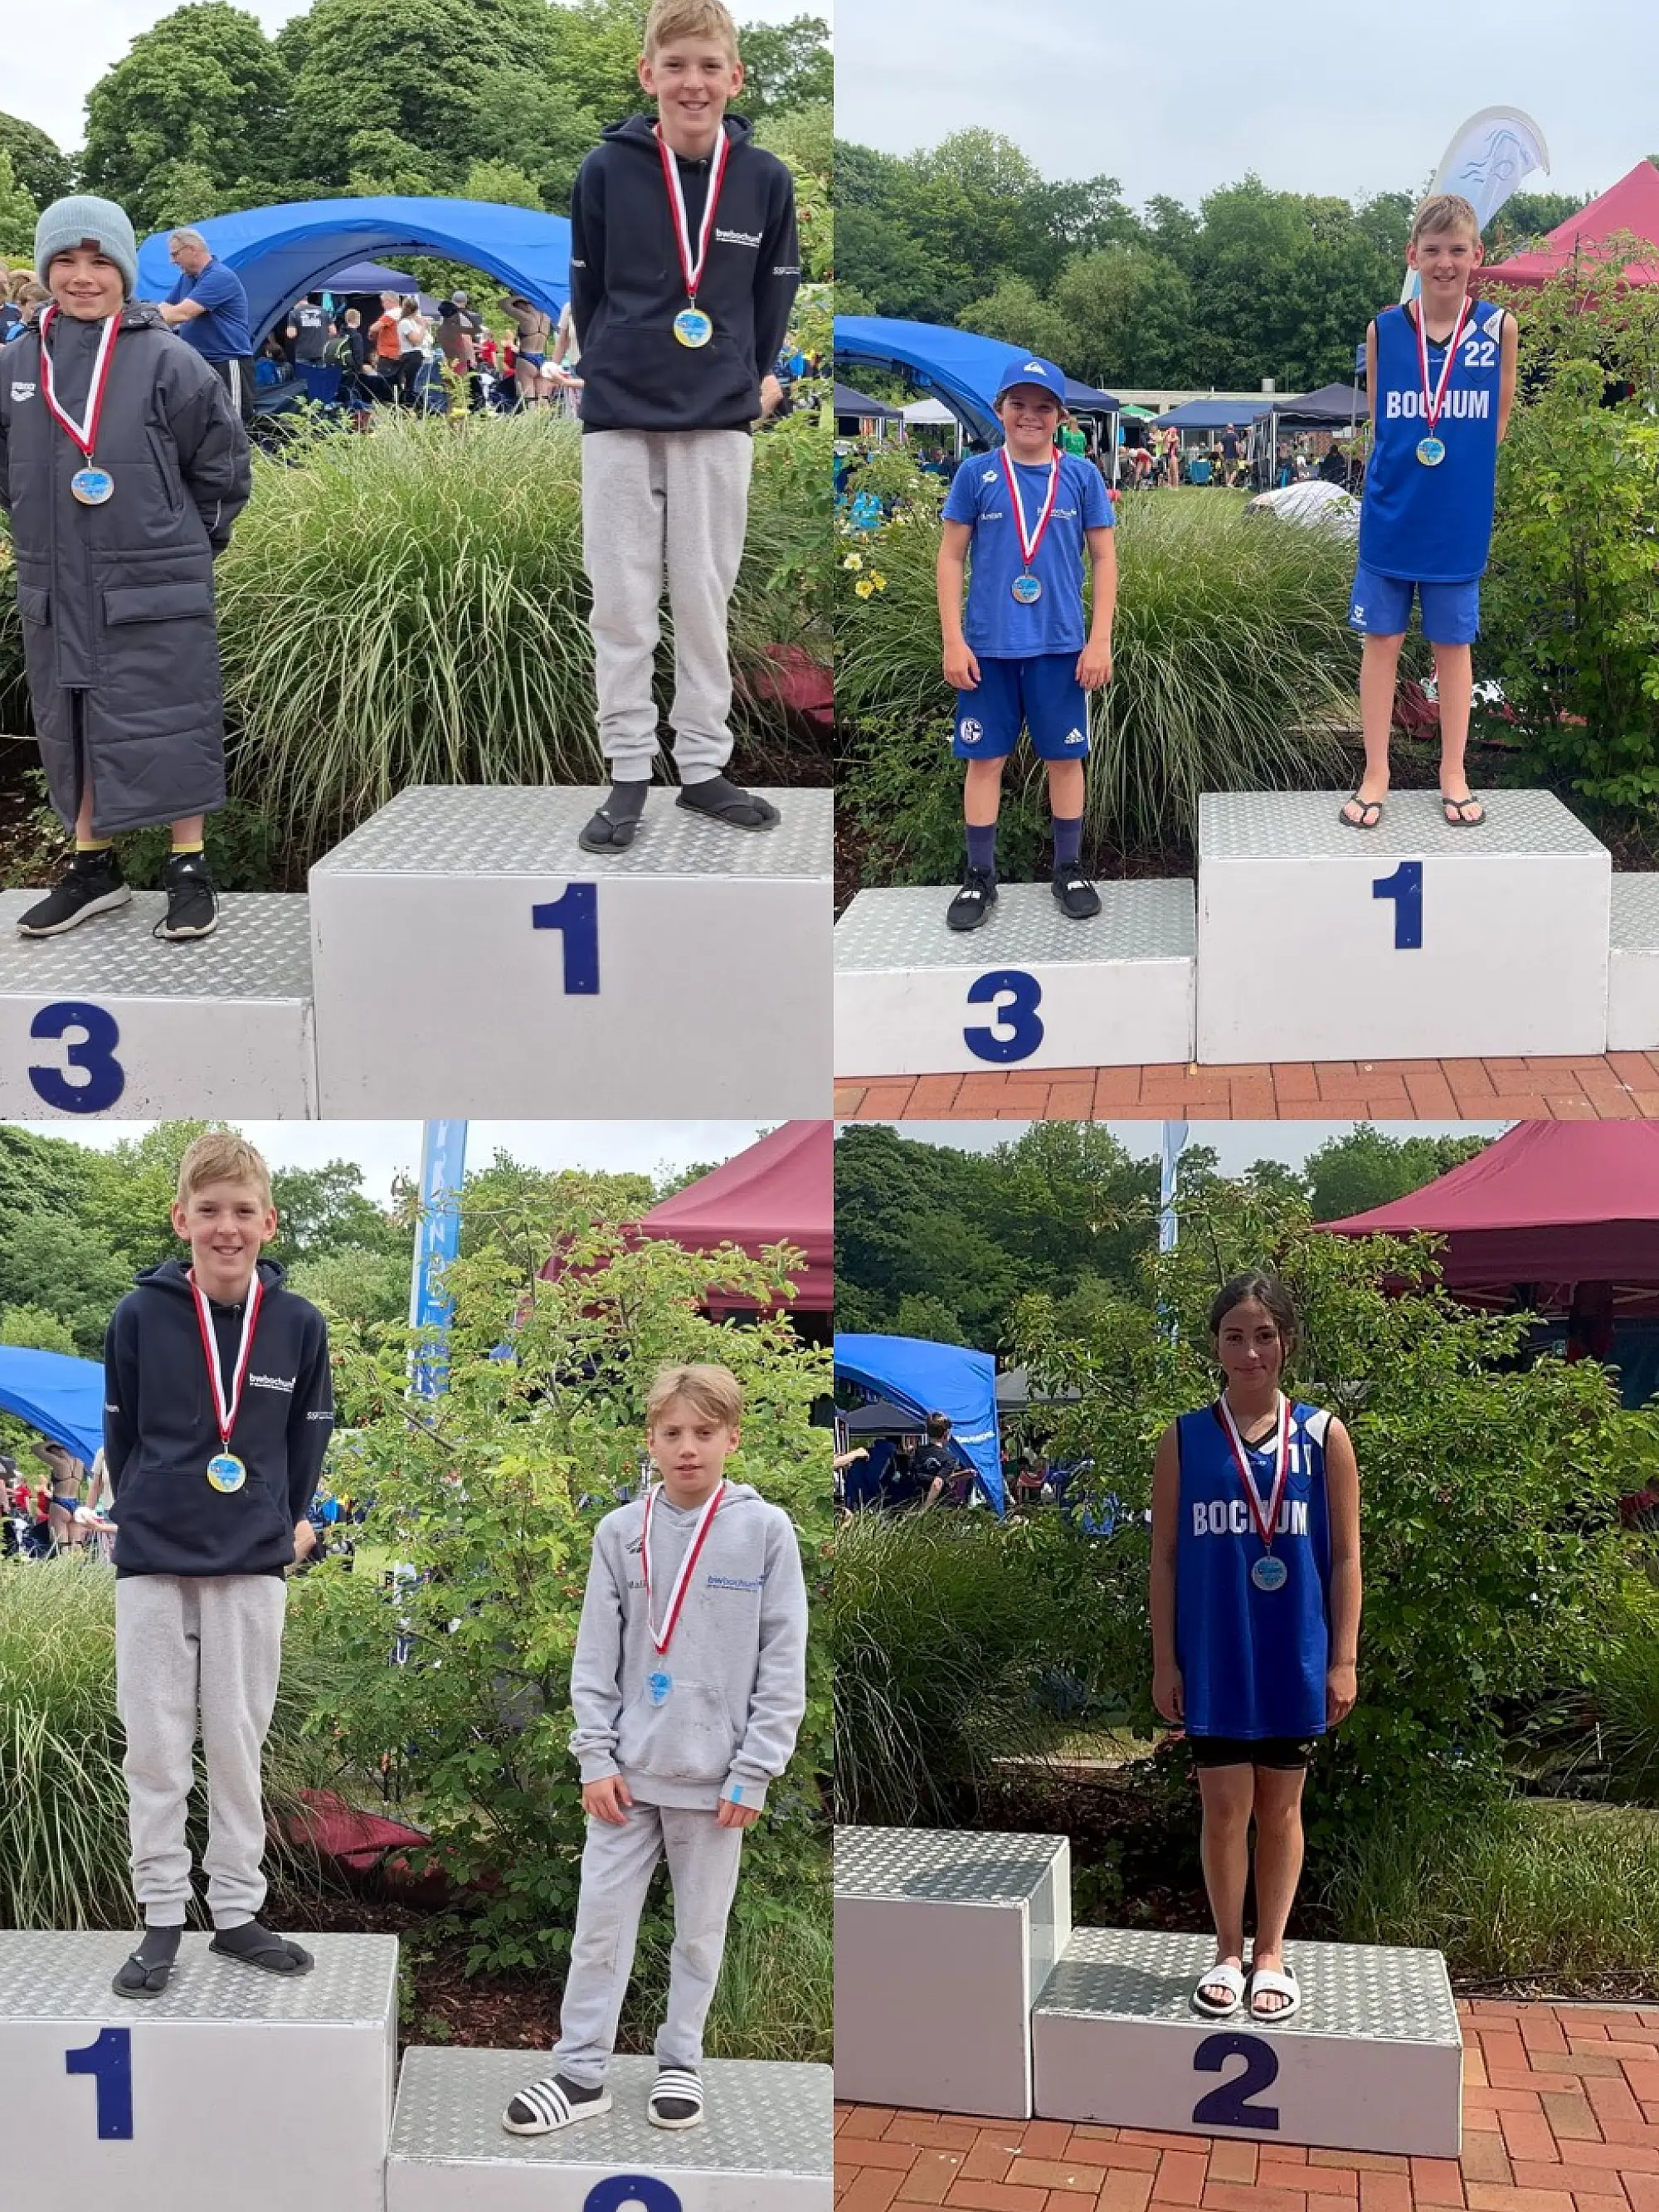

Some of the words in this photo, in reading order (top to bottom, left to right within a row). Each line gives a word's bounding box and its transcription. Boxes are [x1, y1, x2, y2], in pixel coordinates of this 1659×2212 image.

[1464, 341, 1495, 368] 22
[532, 882, 601, 995] 1
[1372, 860, 1423, 949] 1
[28, 1001, 125, 1114] 3
[963, 970, 1044, 1064] 3
[66, 2027, 134, 2141] 1
[1192, 2031, 1280, 2131] 2
